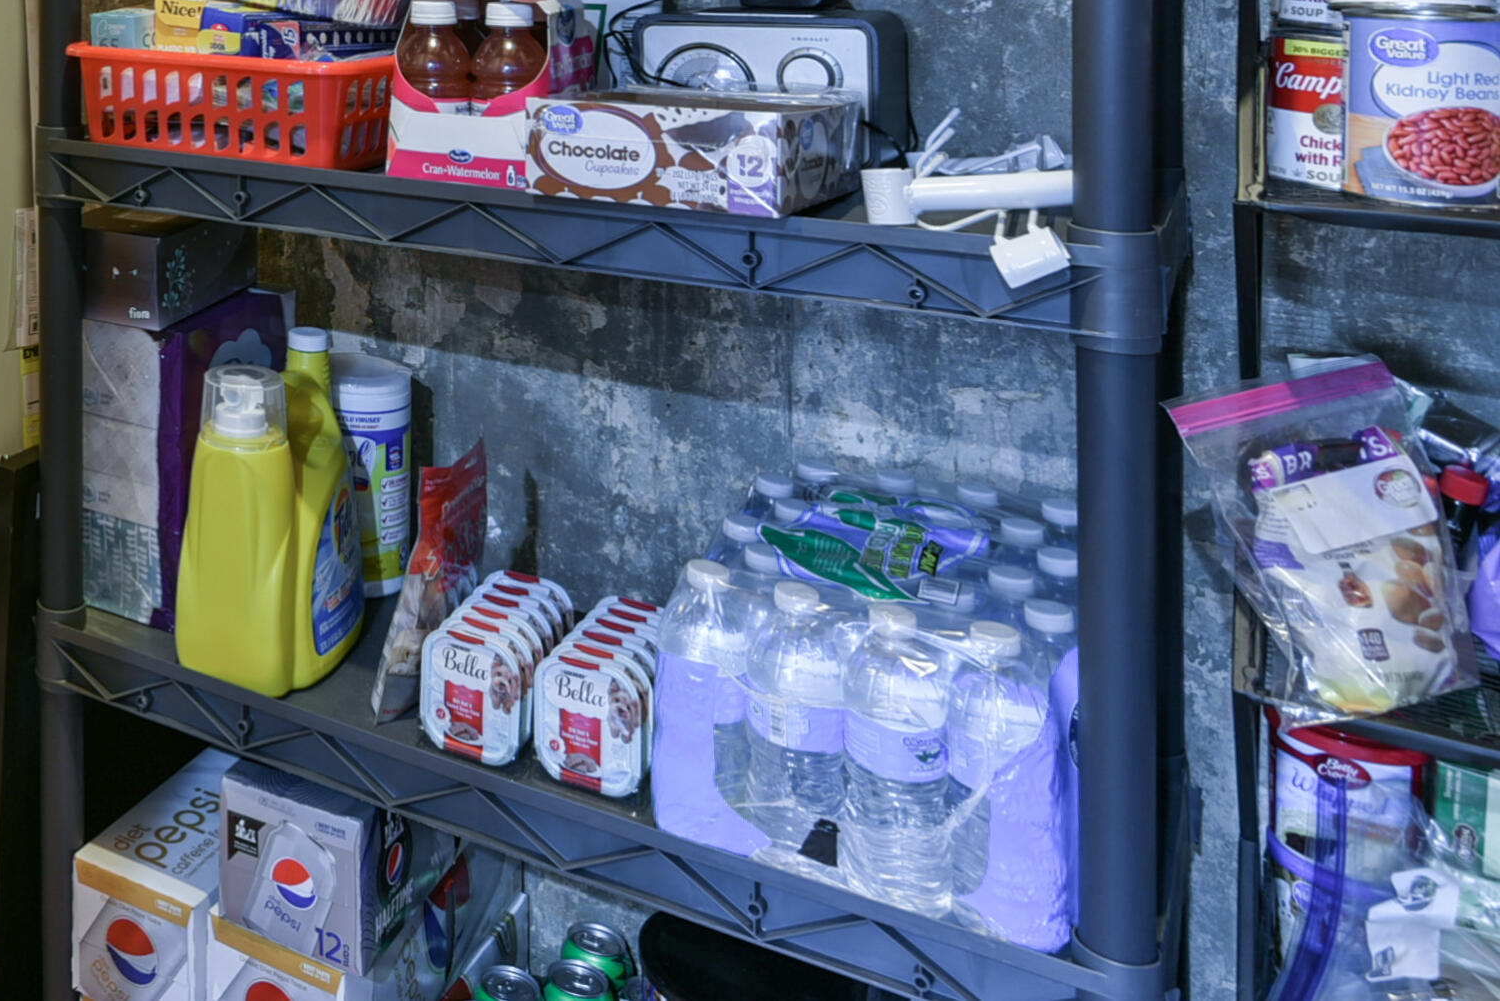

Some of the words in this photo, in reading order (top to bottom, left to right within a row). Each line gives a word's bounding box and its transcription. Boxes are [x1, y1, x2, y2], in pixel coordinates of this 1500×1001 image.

[1290, 6, 1324, 18] SOUP
[282, 27, 299, 46] 15
[1376, 35, 1426, 51] Great
[1387, 47, 1428, 60] Value
[1427, 71, 1470, 87] Light
[1386, 84, 1448, 101] Kidney
[1455, 87, 1499, 100] Beans
[545, 111, 577, 123] Great
[549, 141, 640, 162] Chocolate
[1300, 135, 1342, 150] Chick
[585, 159, 640, 178] Cupcakes
[736, 154, 764, 177] 12
[1295, 151, 1328, 167] with
[507, 173, 514, 186] 6
[1307, 170, 1340, 183] SOU
[442, 647, 489, 681] Bella
[555, 674, 606, 708] Bella
[1326, 756, 1360, 777] Betty
[113, 823, 150, 852] diet
[134, 787, 220, 870] pepsi
[171, 835, 214, 875] caffeine
[264, 897, 302, 932] pepsi
[315, 927, 342, 964] 12
